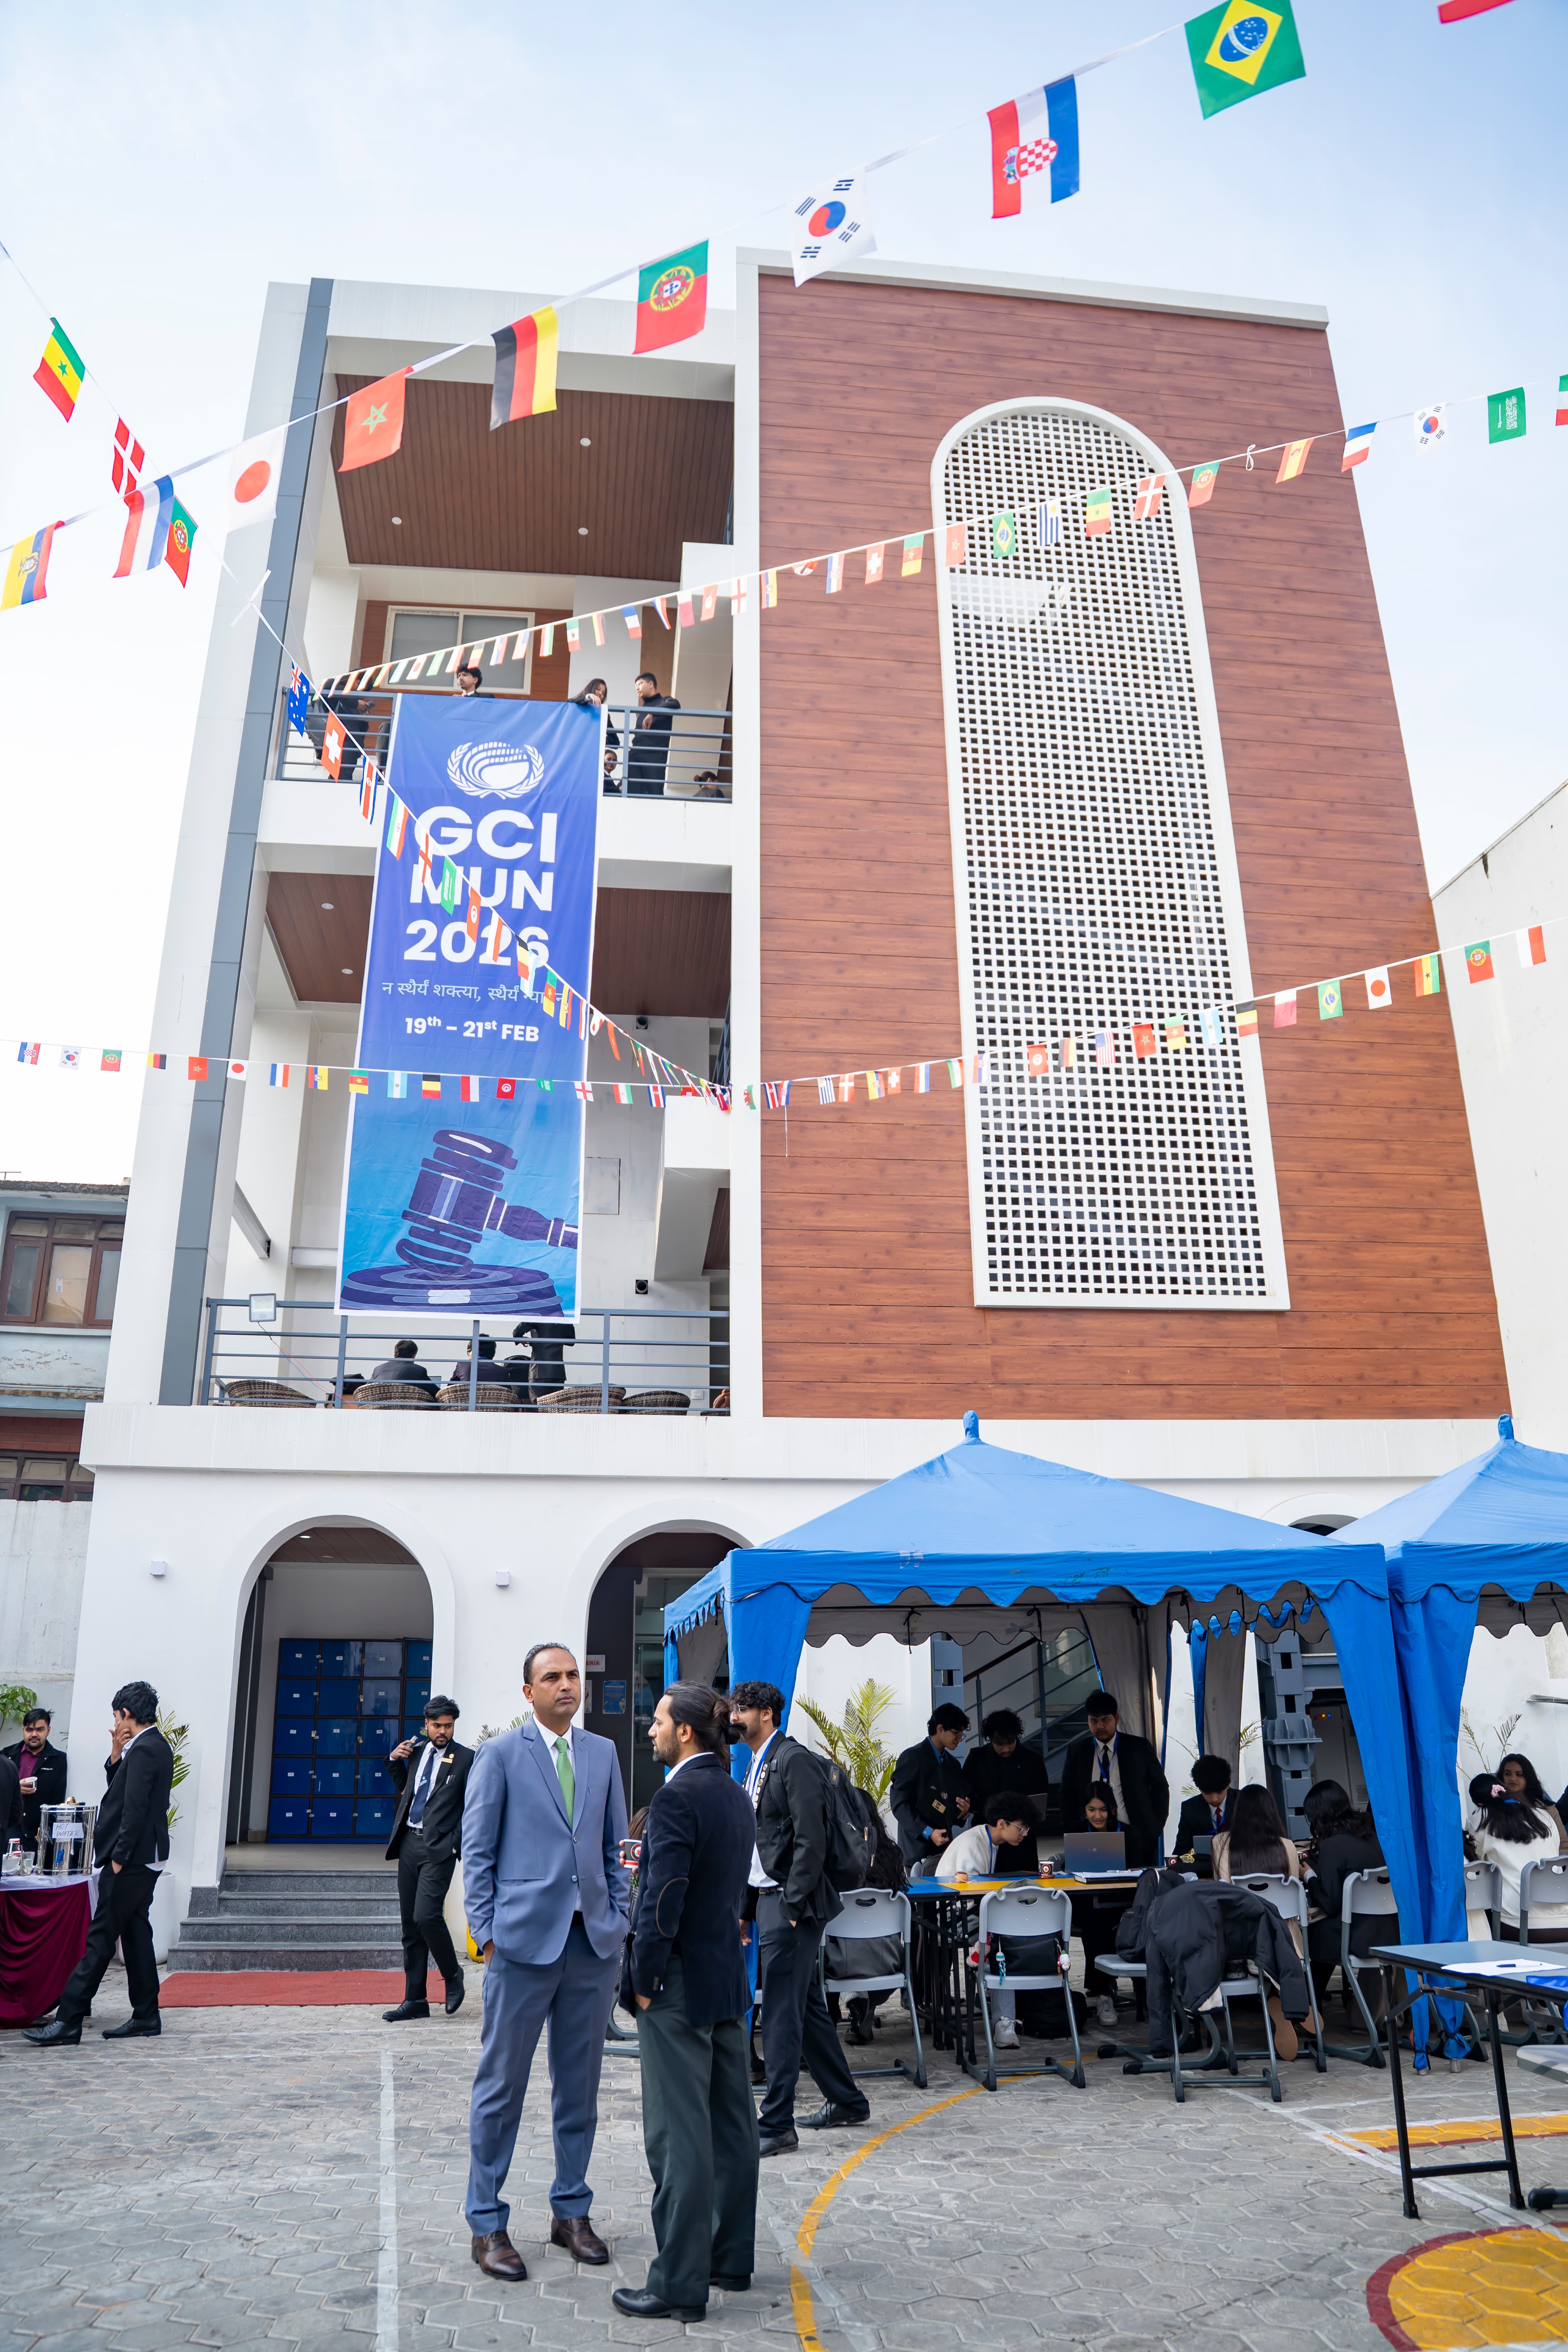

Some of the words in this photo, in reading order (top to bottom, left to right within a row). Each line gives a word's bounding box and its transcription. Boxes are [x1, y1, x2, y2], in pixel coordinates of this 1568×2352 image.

[414, 806, 557, 863] GCI
[410, 864, 554, 911] MUN
[403, 919, 549, 968] 2026
[382, 982, 394, 994] न
[397, 978, 430, 996] स्थैर्यं
[405, 1016, 441, 1034] 19th
[463, 1020, 497, 1038] 21st
[501, 1024, 539, 1042] FEB
